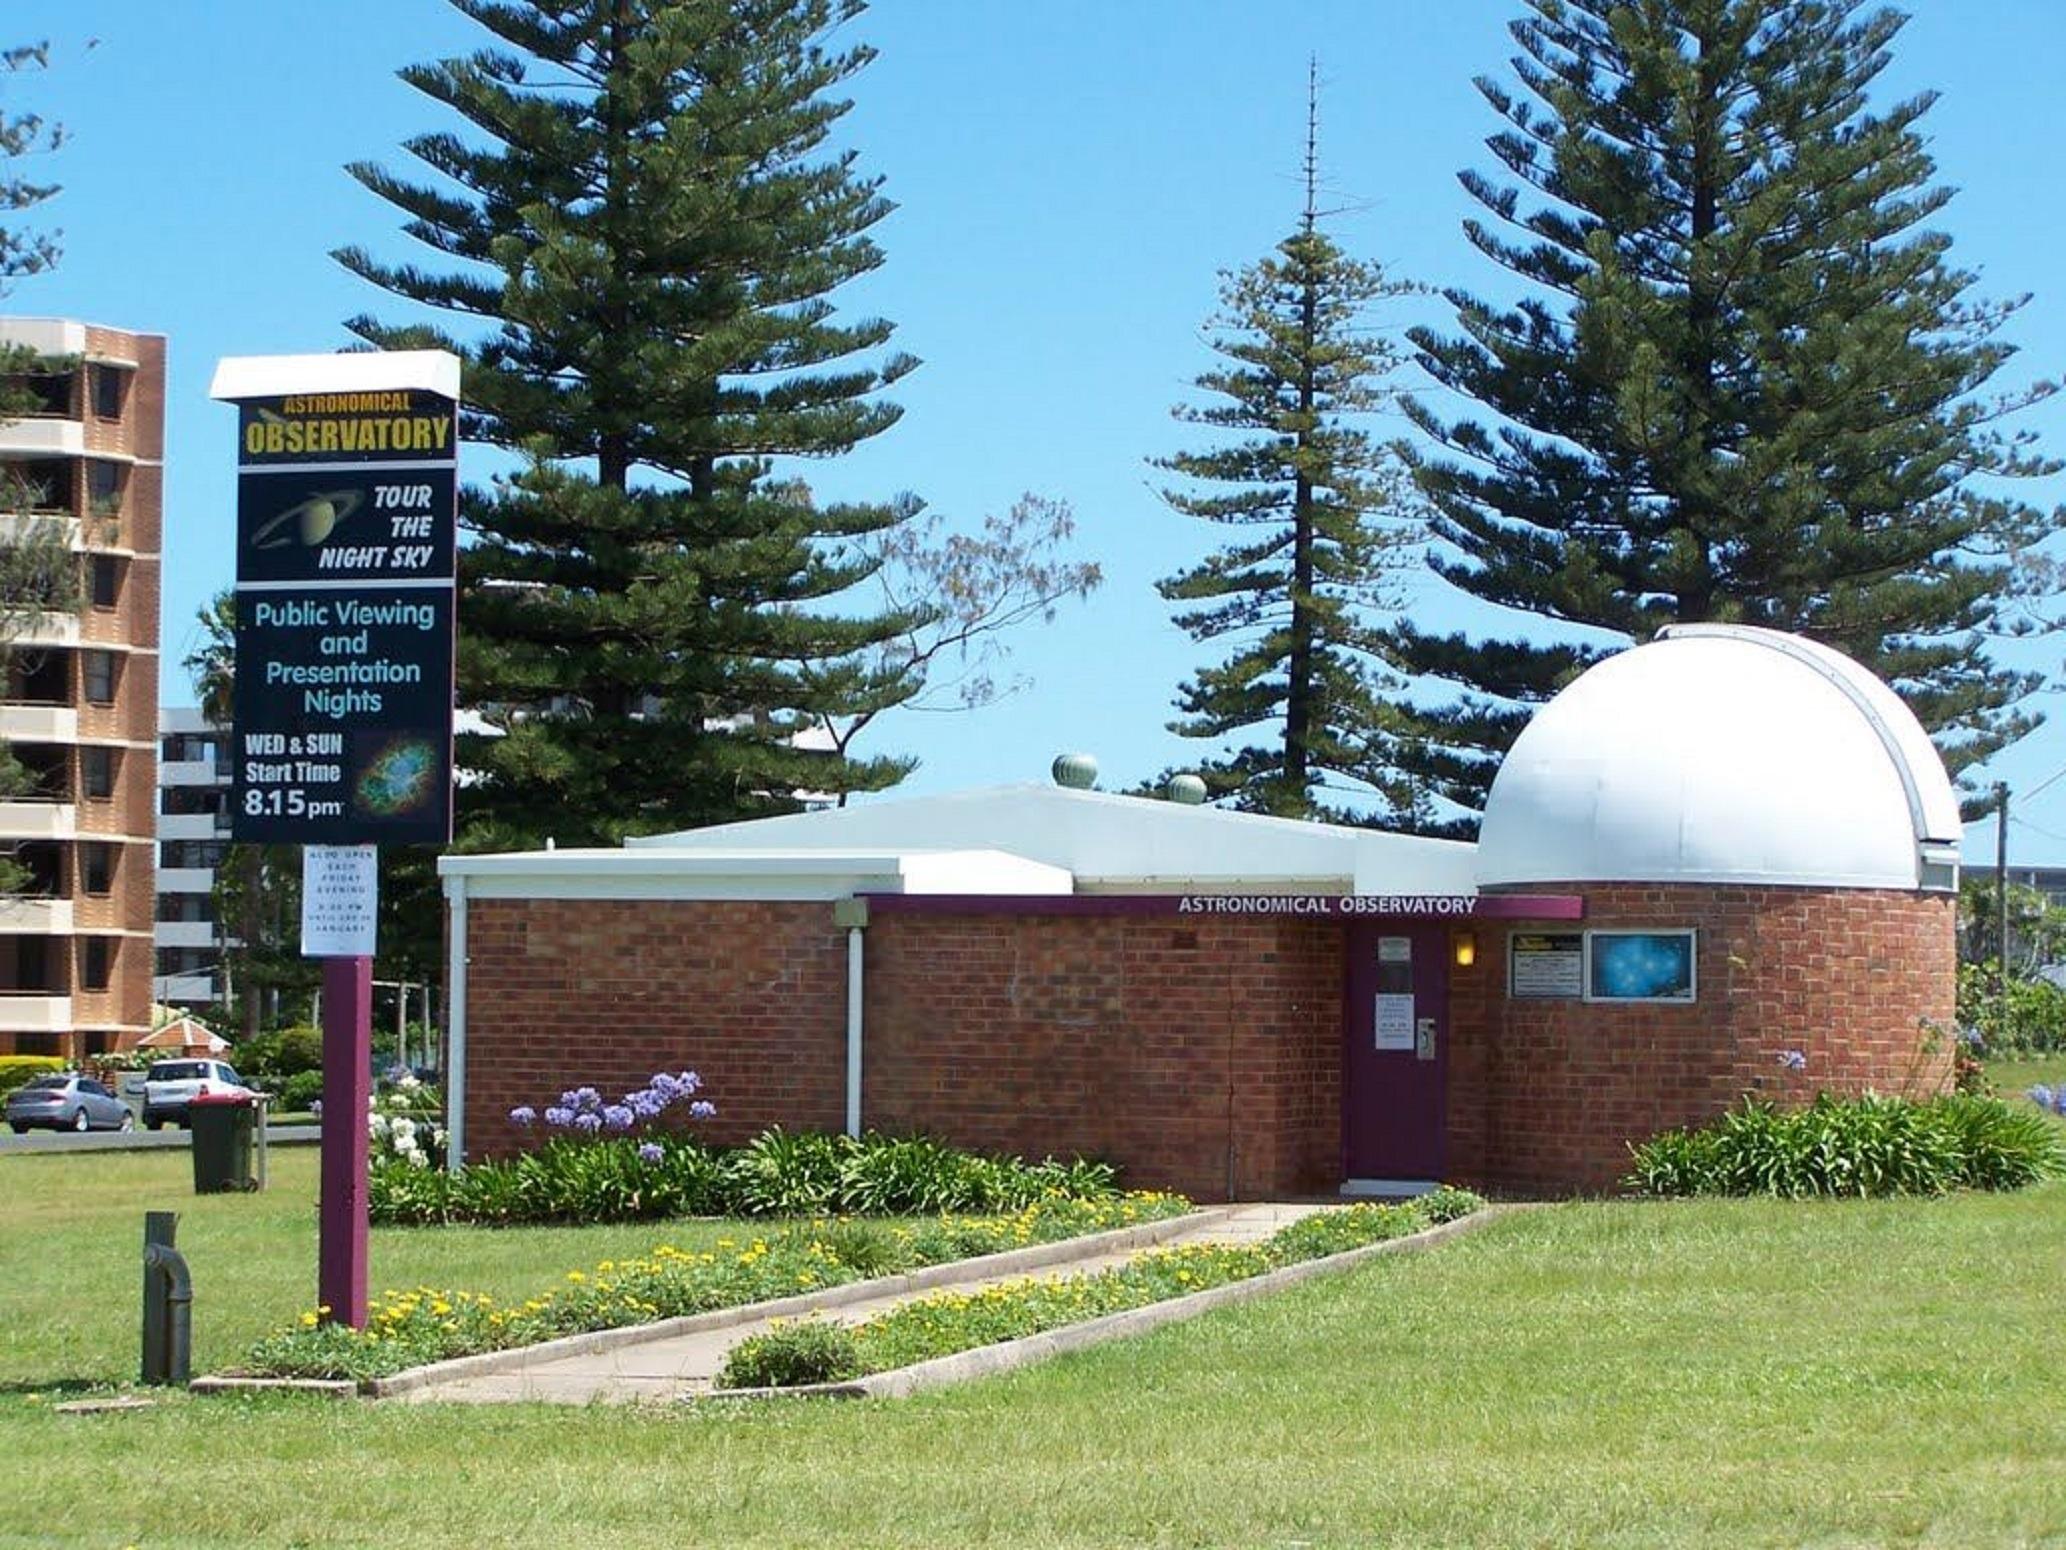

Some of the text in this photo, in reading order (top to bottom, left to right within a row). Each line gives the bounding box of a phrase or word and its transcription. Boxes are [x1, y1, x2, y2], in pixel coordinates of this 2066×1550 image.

[283, 392, 411, 415] ASTRONOMICAL
[246, 416, 450, 454] OBSERVATORY
[374, 485, 433, 508] TOUR
[391, 517, 433, 538] THE
[318, 546, 434, 569] NIGHT SKY
[255, 600, 435, 630] Public Viewing
[320, 630, 368, 655] and
[266, 659, 421, 685] Presentation
[304, 688, 382, 719] Nights
[245, 733, 342, 755] WED & SUN
[246, 761, 341, 782] Start Time
[322, 874, 360, 882] FRIDAY
[1179, 896, 1477, 913] ASTRONOMICAL OBSERVATORY
